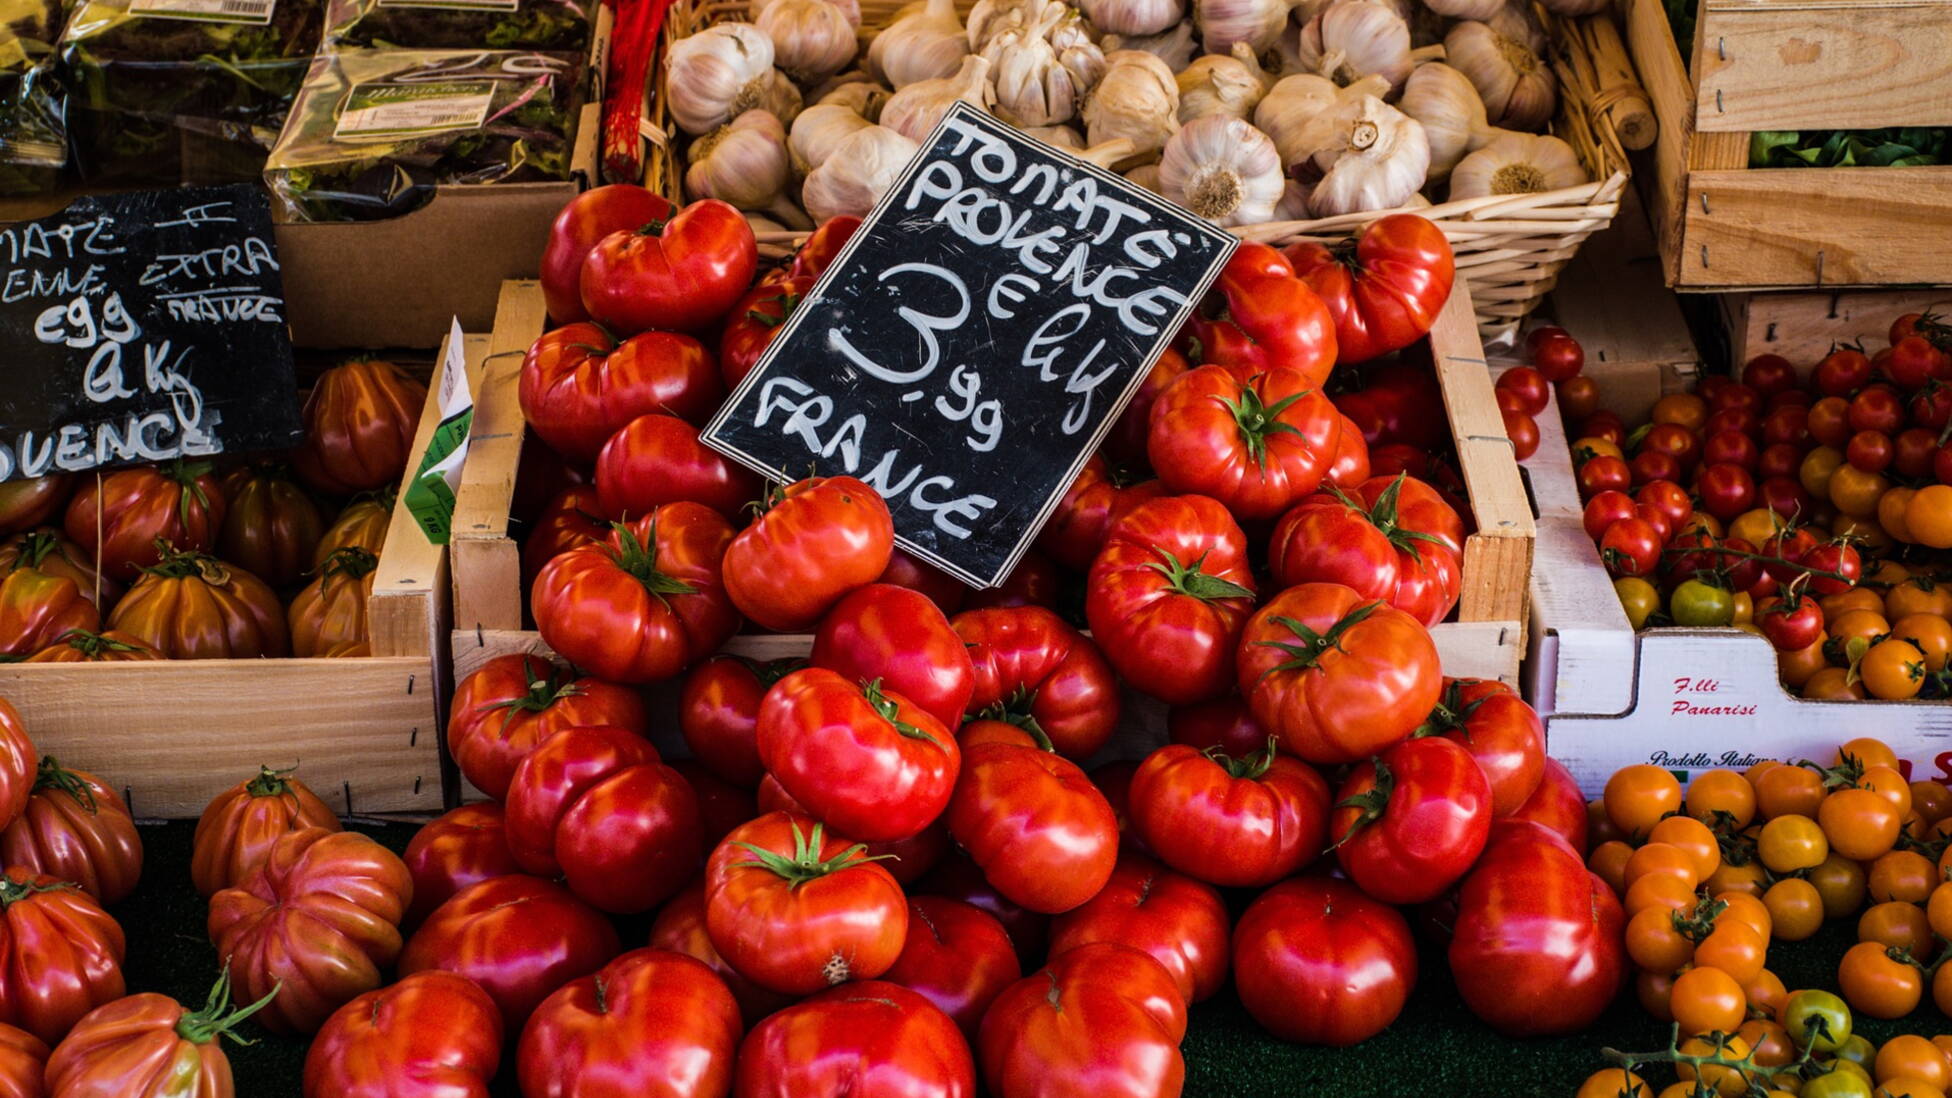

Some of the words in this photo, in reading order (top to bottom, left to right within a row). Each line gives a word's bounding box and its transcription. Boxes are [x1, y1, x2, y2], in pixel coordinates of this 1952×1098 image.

[139, 237, 280, 286] EXTRA
[905, 160, 1190, 335] PROVENCE
[753, 376, 998, 540] FRANCE
[1671, 700, 1758, 716] Panarisi
[1646, 750, 1711, 767] Prodotto
